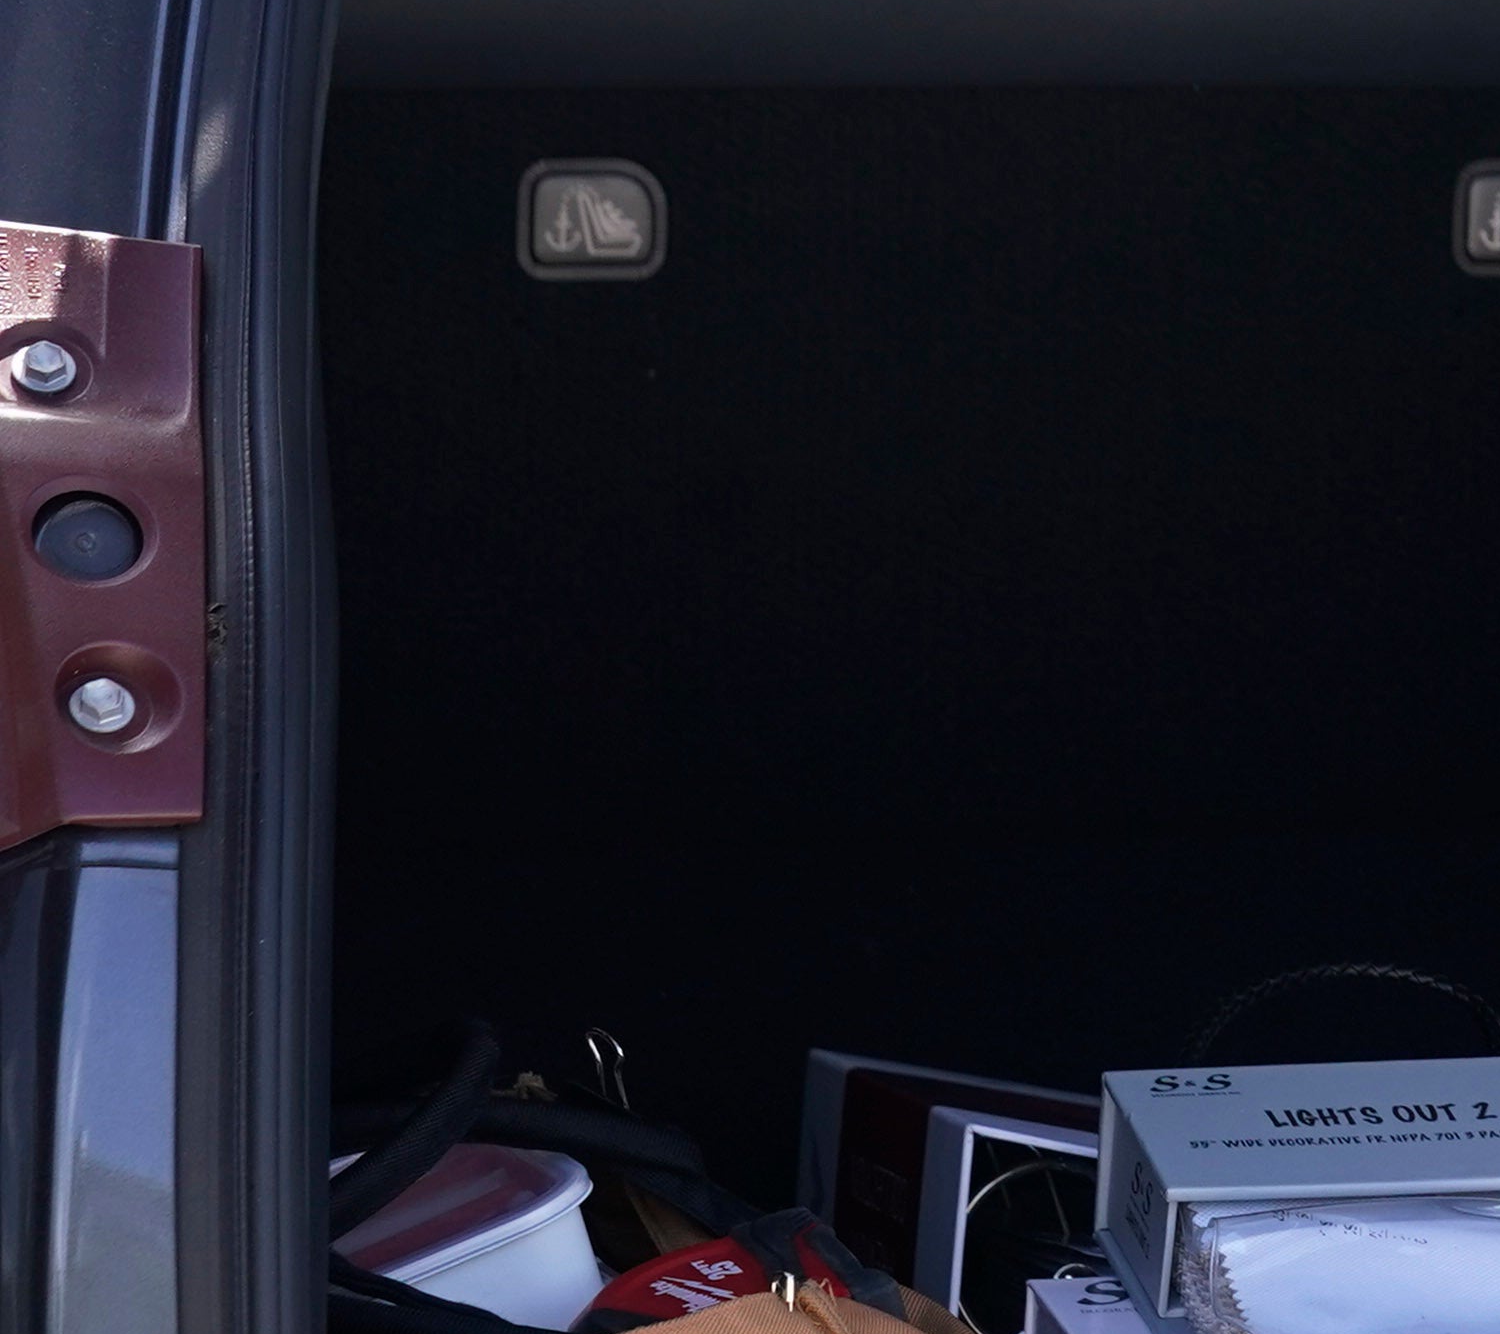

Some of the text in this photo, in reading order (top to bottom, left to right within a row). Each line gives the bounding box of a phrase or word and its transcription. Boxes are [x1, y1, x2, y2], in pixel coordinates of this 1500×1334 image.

[1264, 1101, 1499, 1128] LIGHTS OUT 2
